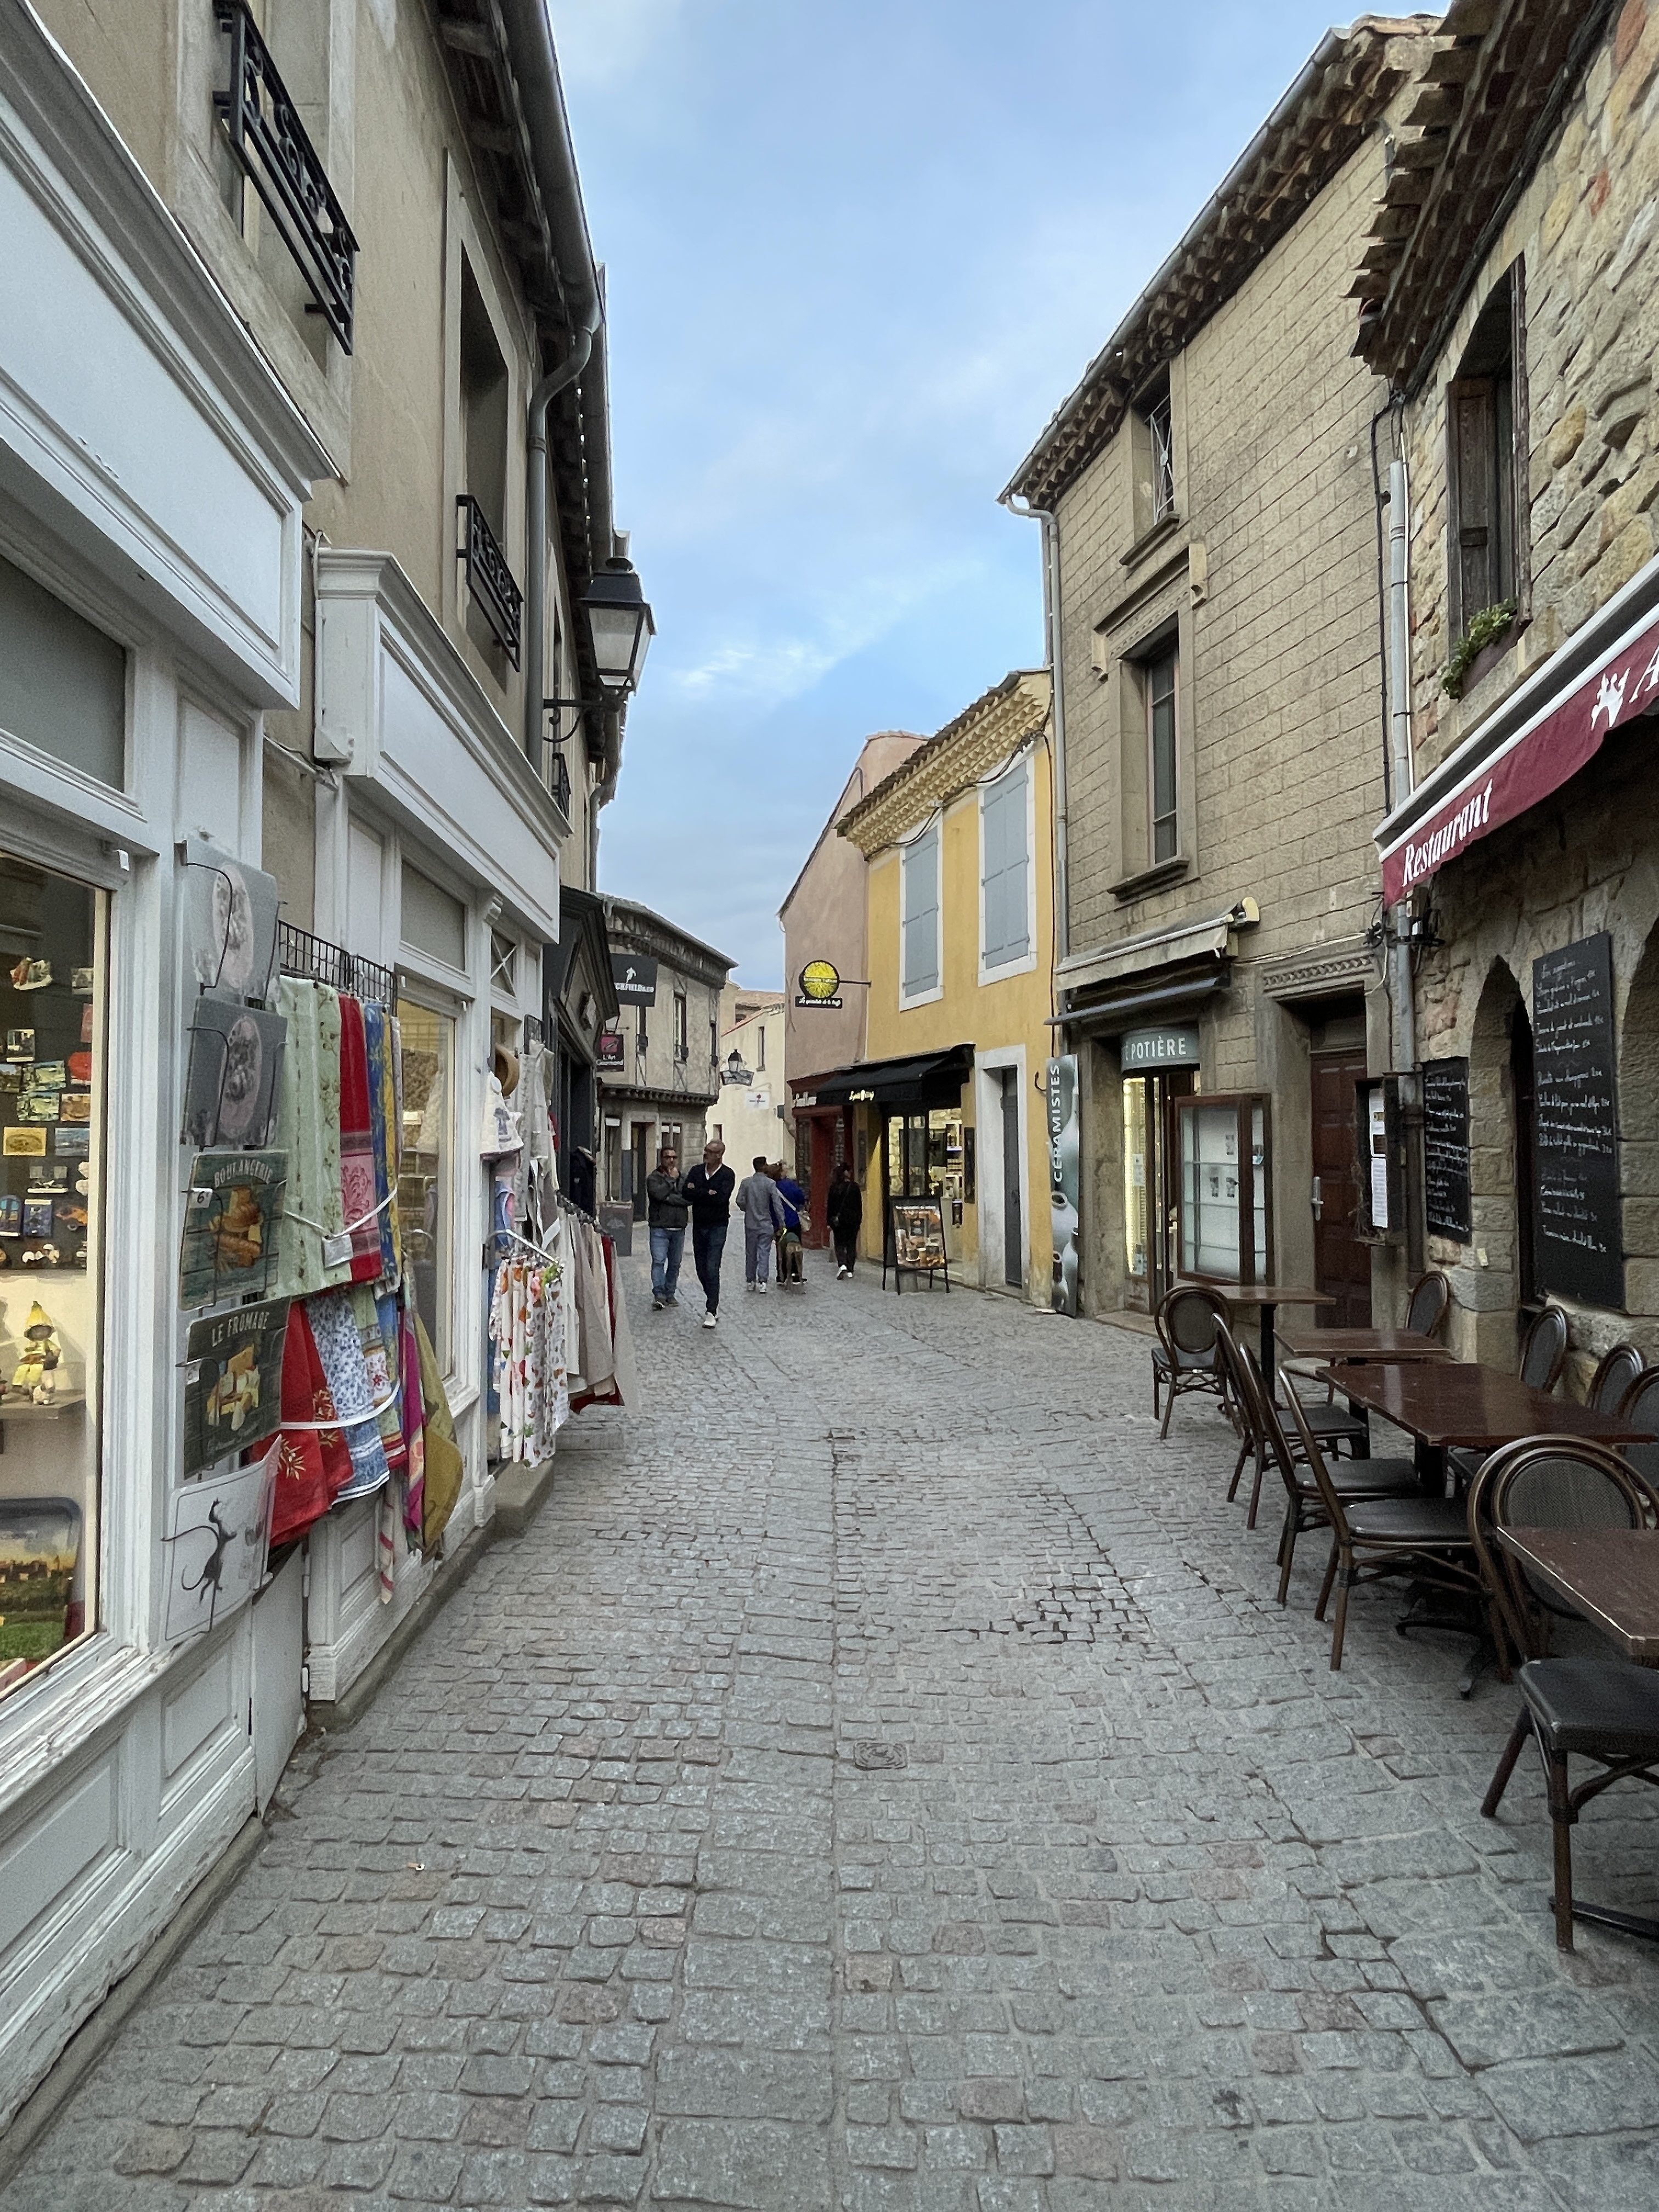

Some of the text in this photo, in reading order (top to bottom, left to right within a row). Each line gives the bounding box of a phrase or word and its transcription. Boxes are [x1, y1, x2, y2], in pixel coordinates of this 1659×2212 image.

[1402, 778, 1493, 887] Restaurant
[1131, 1035, 1186, 1060] POTIÈRE
[214, 1159, 273, 1188] BOULANGERIE
[212, 1311, 270, 1347] LE FROMAGE
